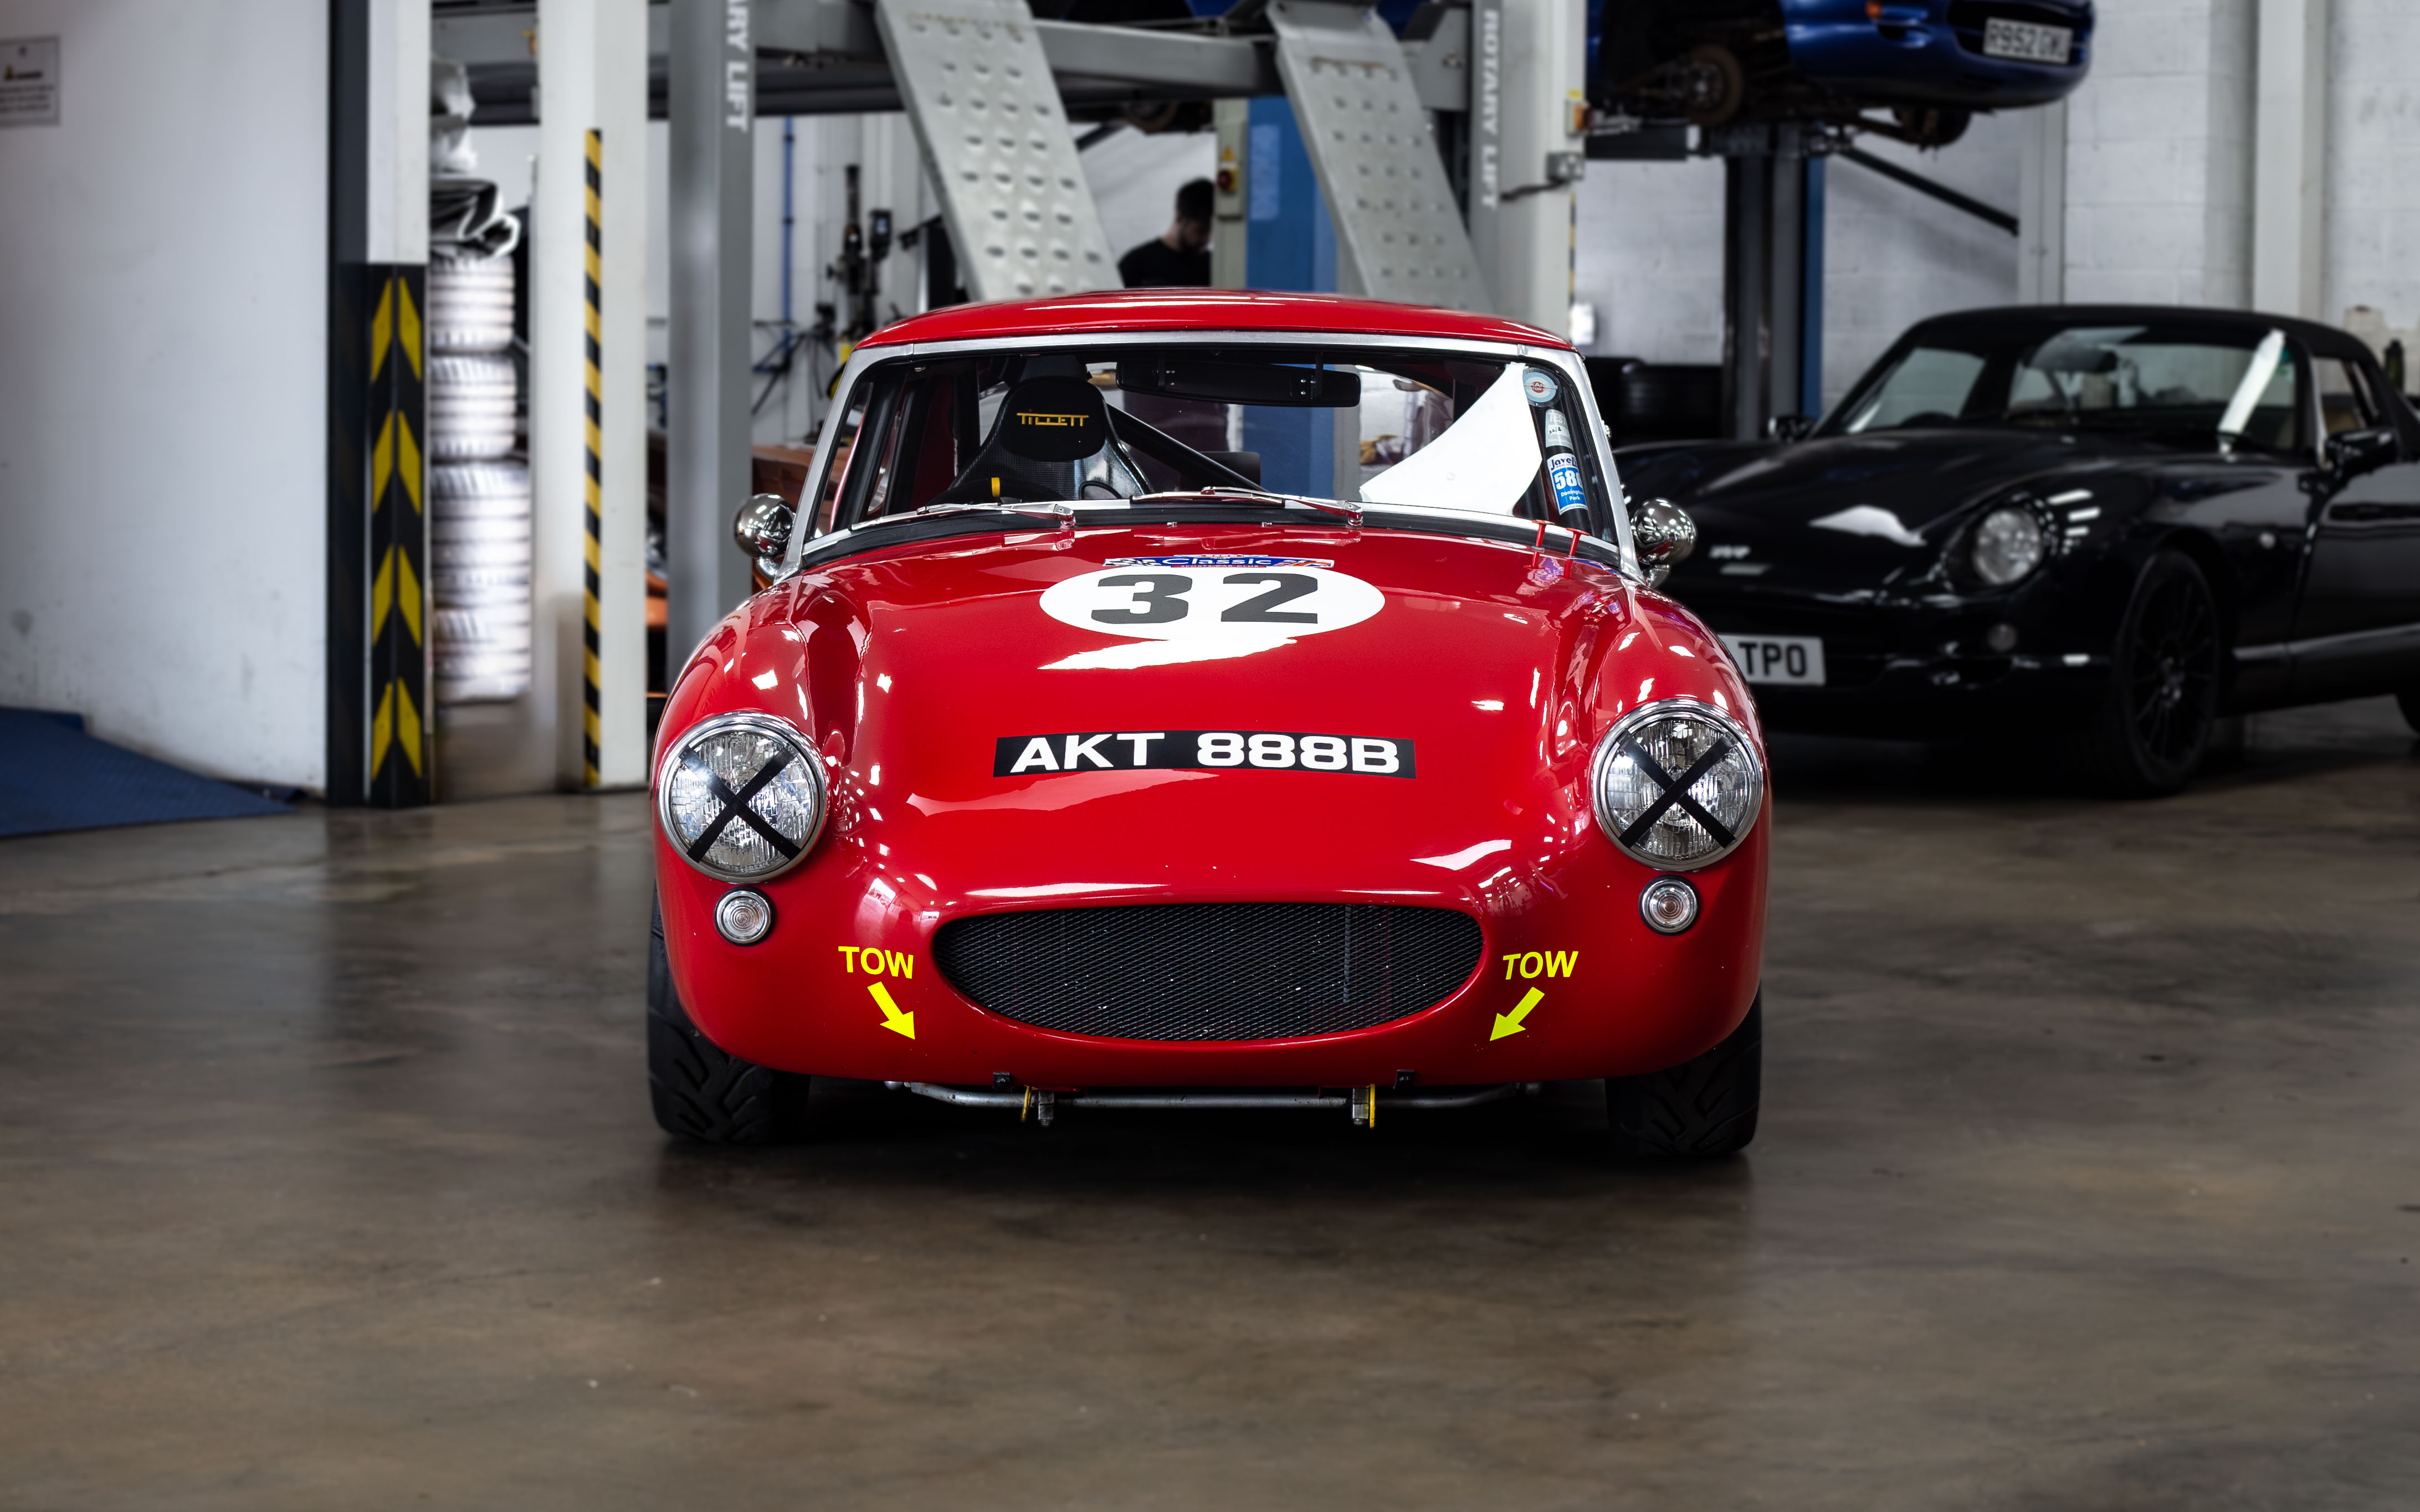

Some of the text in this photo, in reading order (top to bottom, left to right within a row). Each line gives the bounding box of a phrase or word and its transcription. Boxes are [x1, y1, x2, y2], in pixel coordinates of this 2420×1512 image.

[726, 61, 748, 133] LIFT
[1481, 9, 1499, 211] ROTARY LIFT
[1091, 573, 1318, 624] 32
[1738, 641, 1807, 680] TPO
[1011, 733, 1399, 774] AKT 888B
[838, 946, 914, 979] TOW
[1503, 951, 1578, 980] TOW
